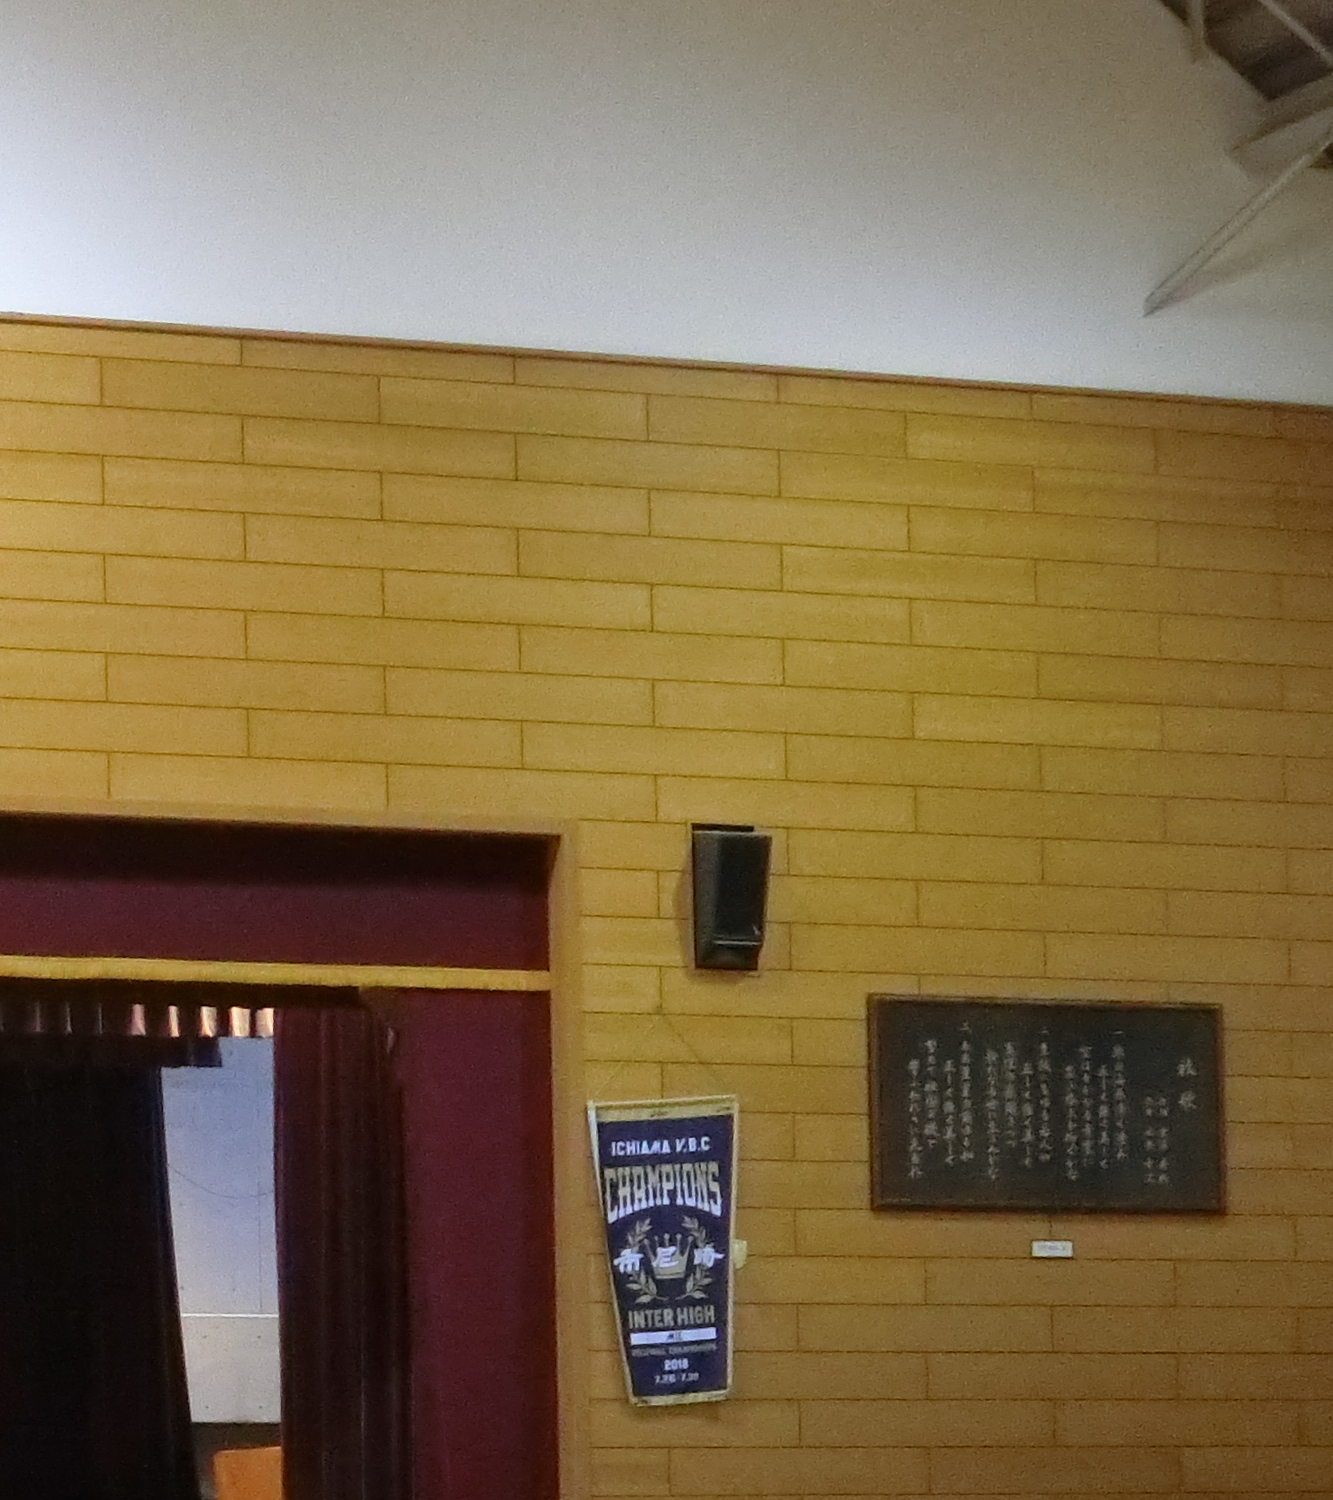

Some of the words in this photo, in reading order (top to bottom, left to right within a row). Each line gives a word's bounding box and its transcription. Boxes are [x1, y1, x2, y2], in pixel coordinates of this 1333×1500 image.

[604, 1160, 722, 1225] CHAMPIONS
[628, 1308, 674, 1329] INTER
[676, 1304, 716, 1326] HIGH
